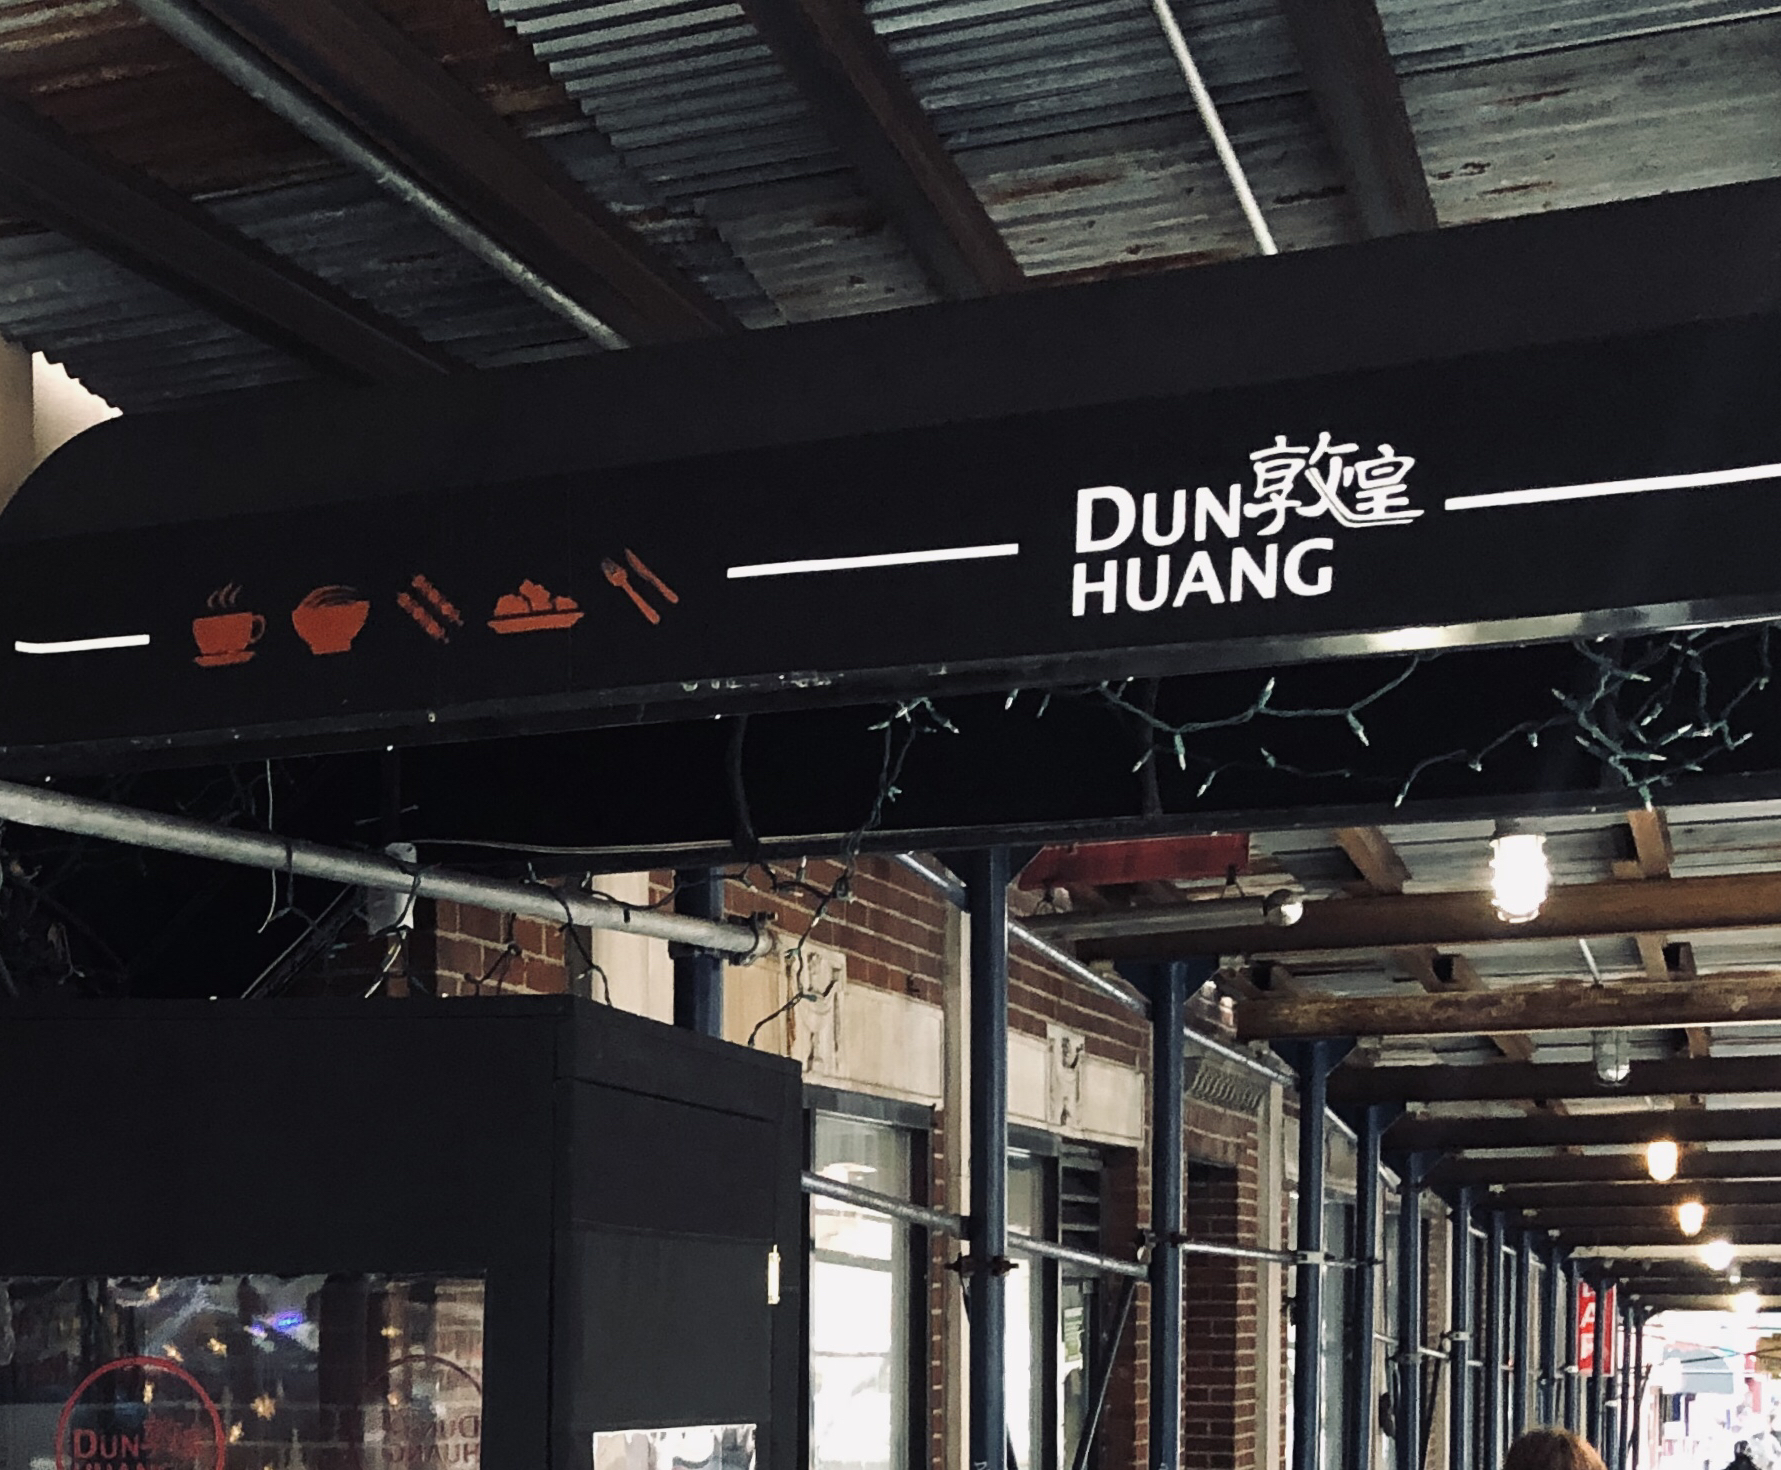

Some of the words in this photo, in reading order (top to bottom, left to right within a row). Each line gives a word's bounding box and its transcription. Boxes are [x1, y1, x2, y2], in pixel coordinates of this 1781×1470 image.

[1075, 484, 1242, 553] DUN
[1072, 538, 1334, 617] HUANG
[73, 1429, 139, 1459] DUN
